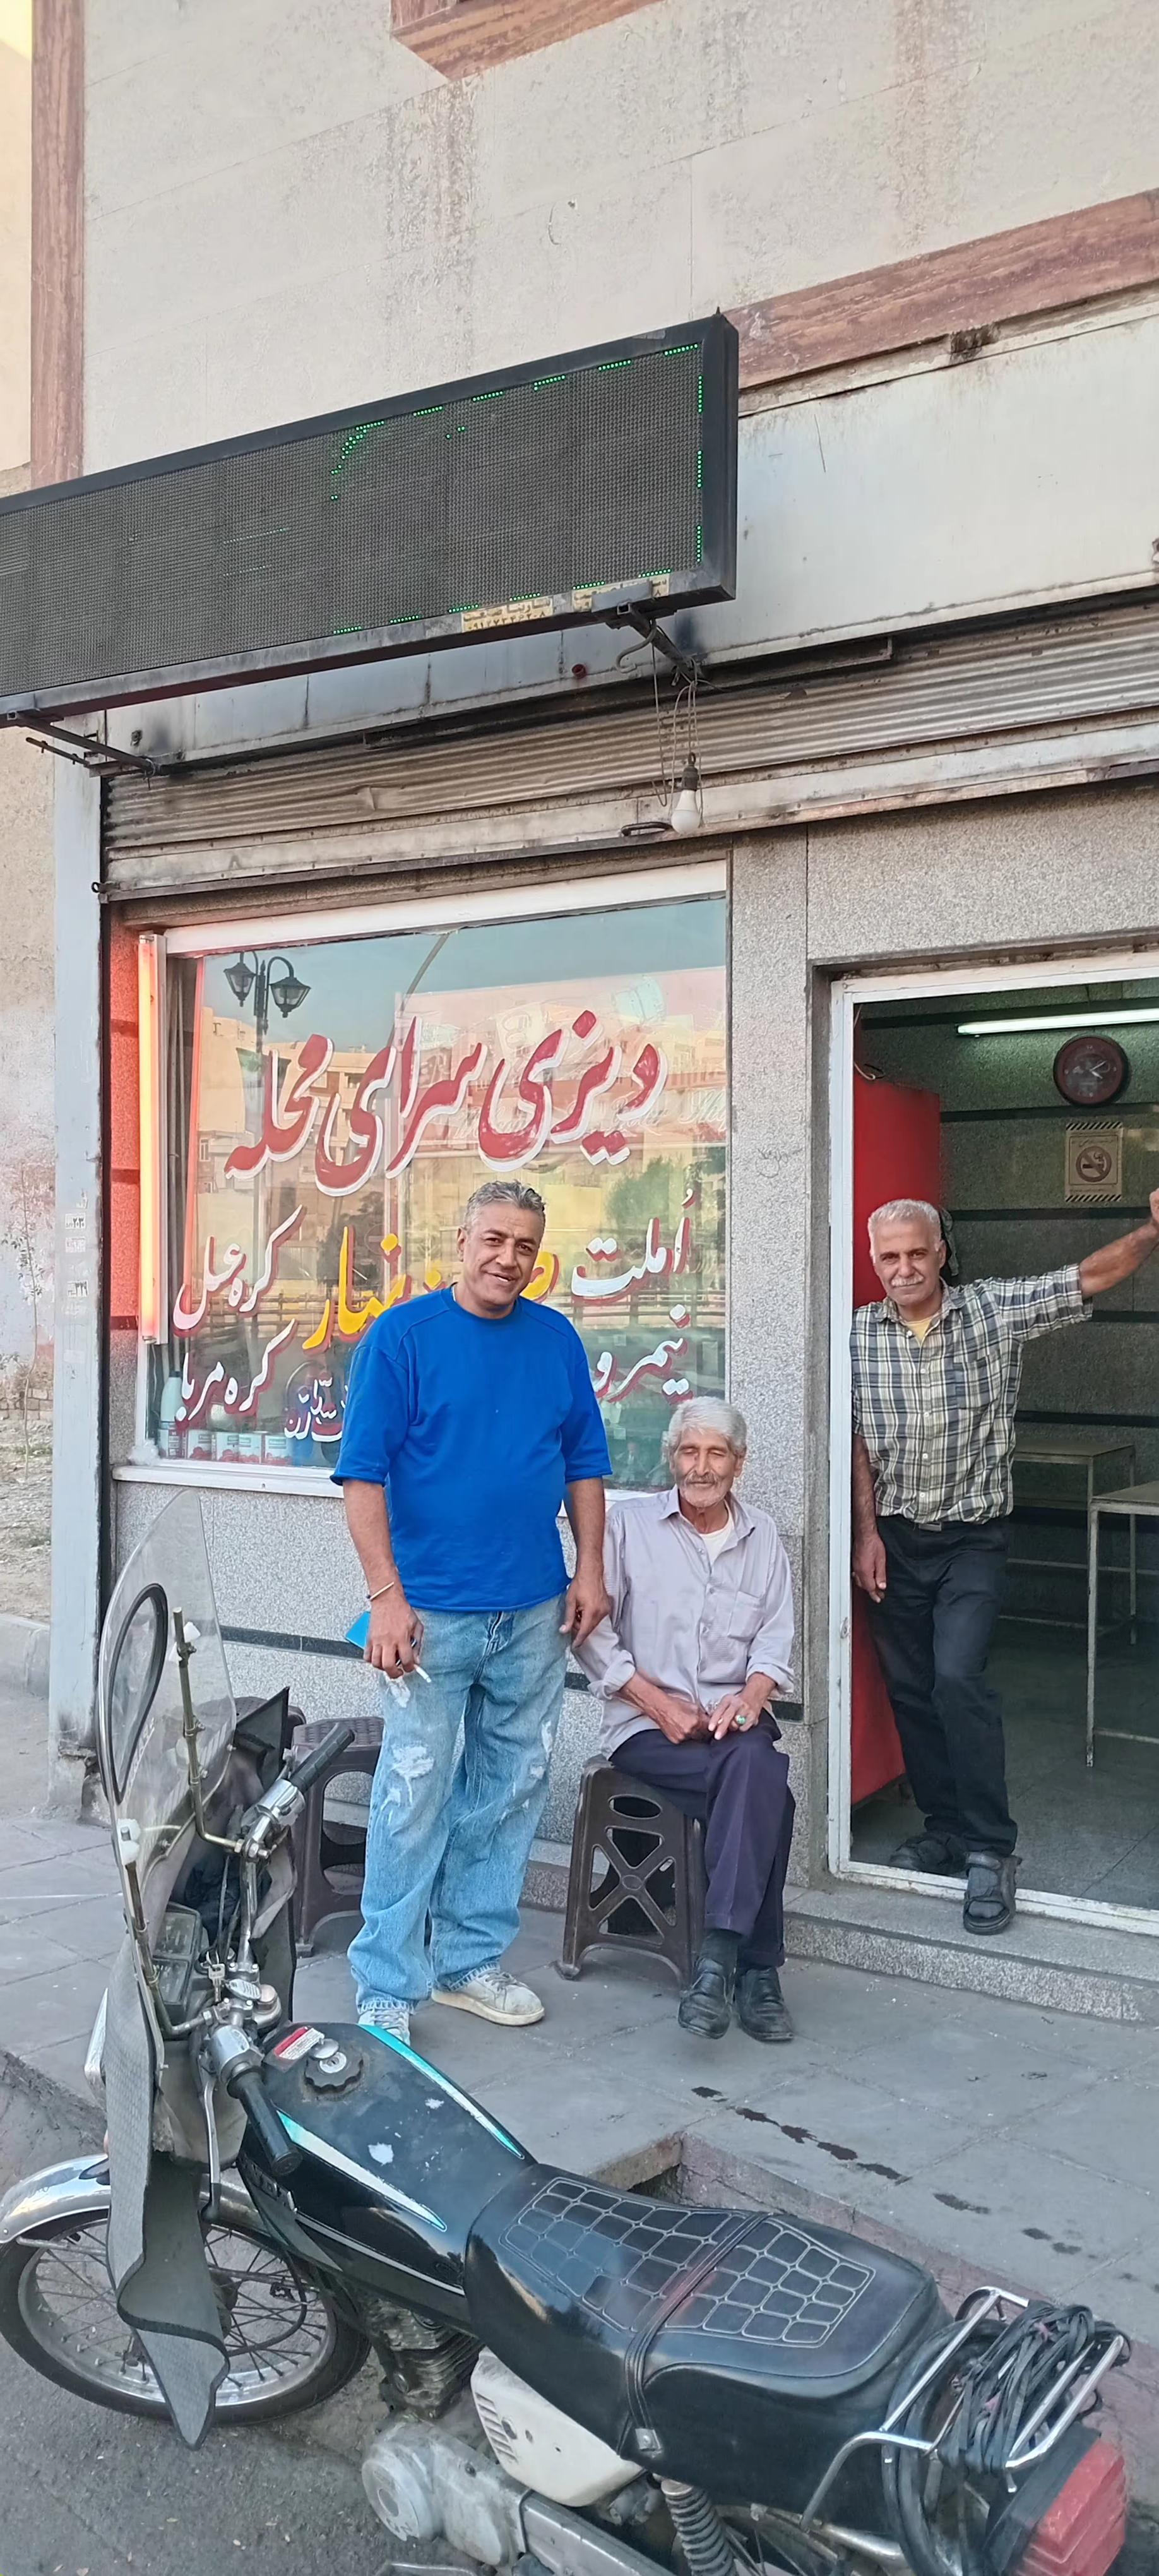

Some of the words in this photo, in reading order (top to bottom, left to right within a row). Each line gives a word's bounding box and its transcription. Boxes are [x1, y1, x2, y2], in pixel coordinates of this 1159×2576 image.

[223, 1034, 335, 1179] محله
[315, 1016, 487, 1197] سرای
[478, 1010, 668, 1171] دیزی
[228, 1204, 306, 1315] کره
[175, 1352, 226, 1423] مربا
[224, 1318, 298, 1413] کره
